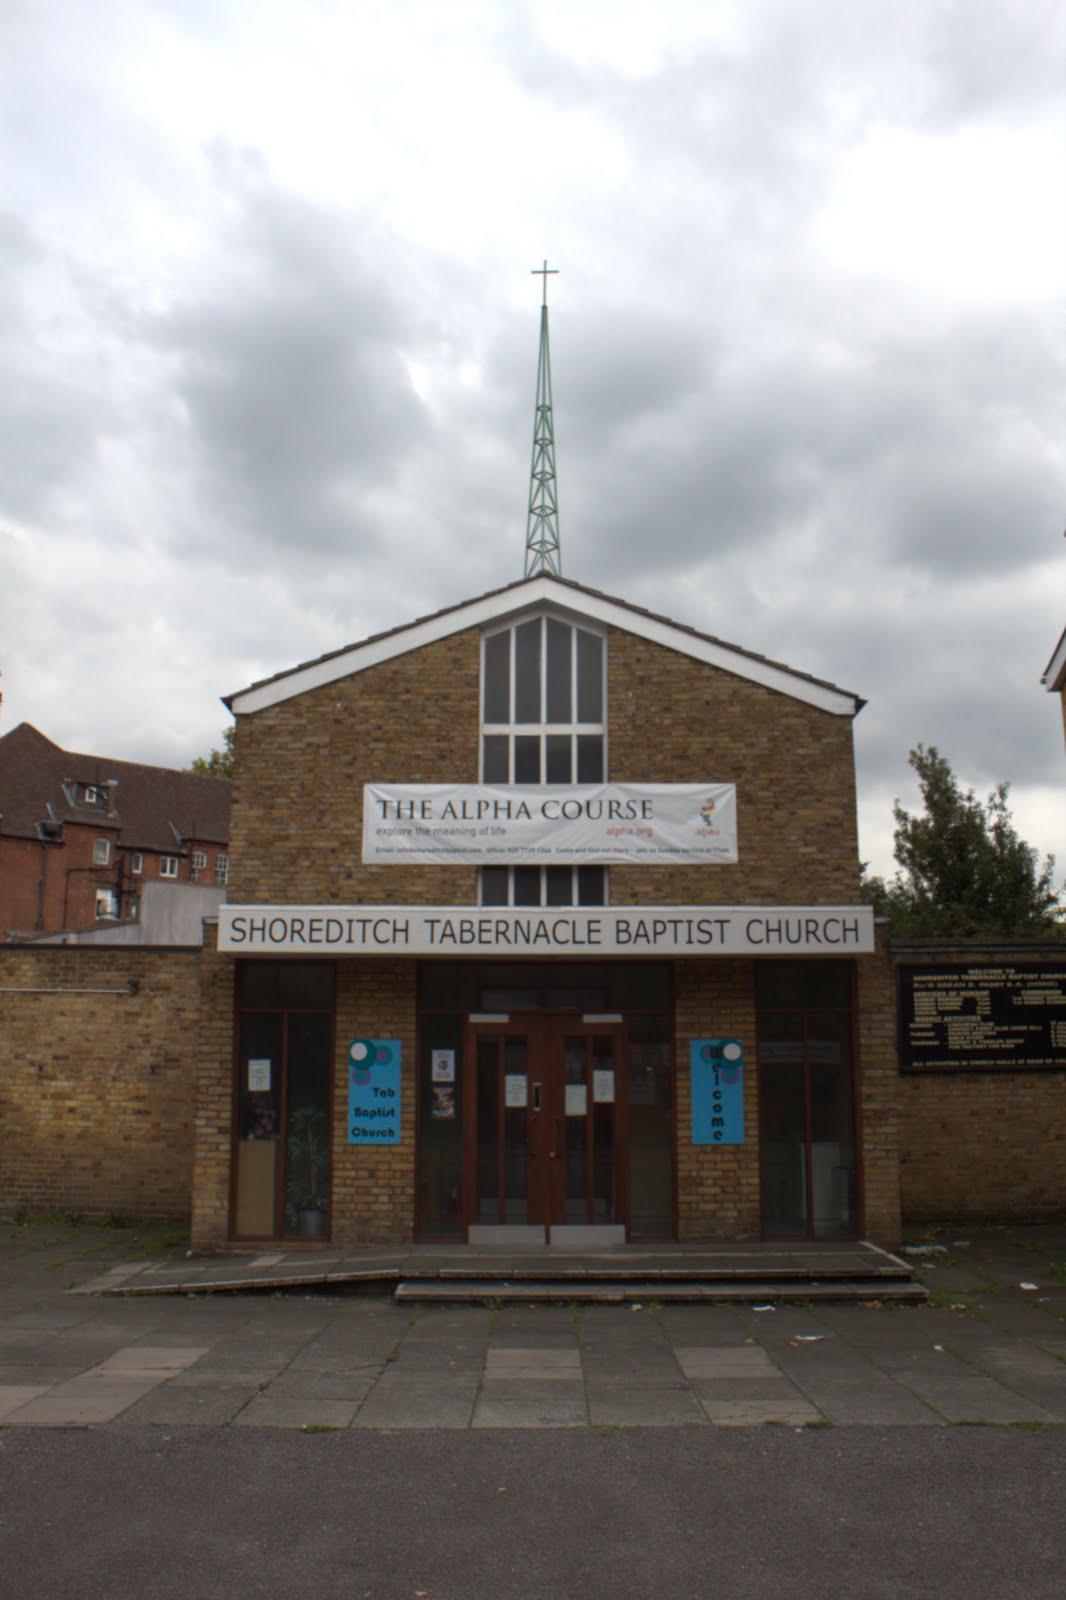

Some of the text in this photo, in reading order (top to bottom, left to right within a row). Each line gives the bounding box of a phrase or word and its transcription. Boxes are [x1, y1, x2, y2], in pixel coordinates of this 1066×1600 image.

[376, 799, 653, 820] THE ALPHA COURSE
[376, 825, 507, 837] explore the meaning of life
[606, 826, 653, 838] alpha.org
[230, 917, 859, 945] SHOREDITCH TABERNACLE BAPTIST CHURCH
[373, 1087, 395, 1097] Tab
[354, 1107, 395, 1119] Baptist
[352, 1127, 395, 1138] Church
